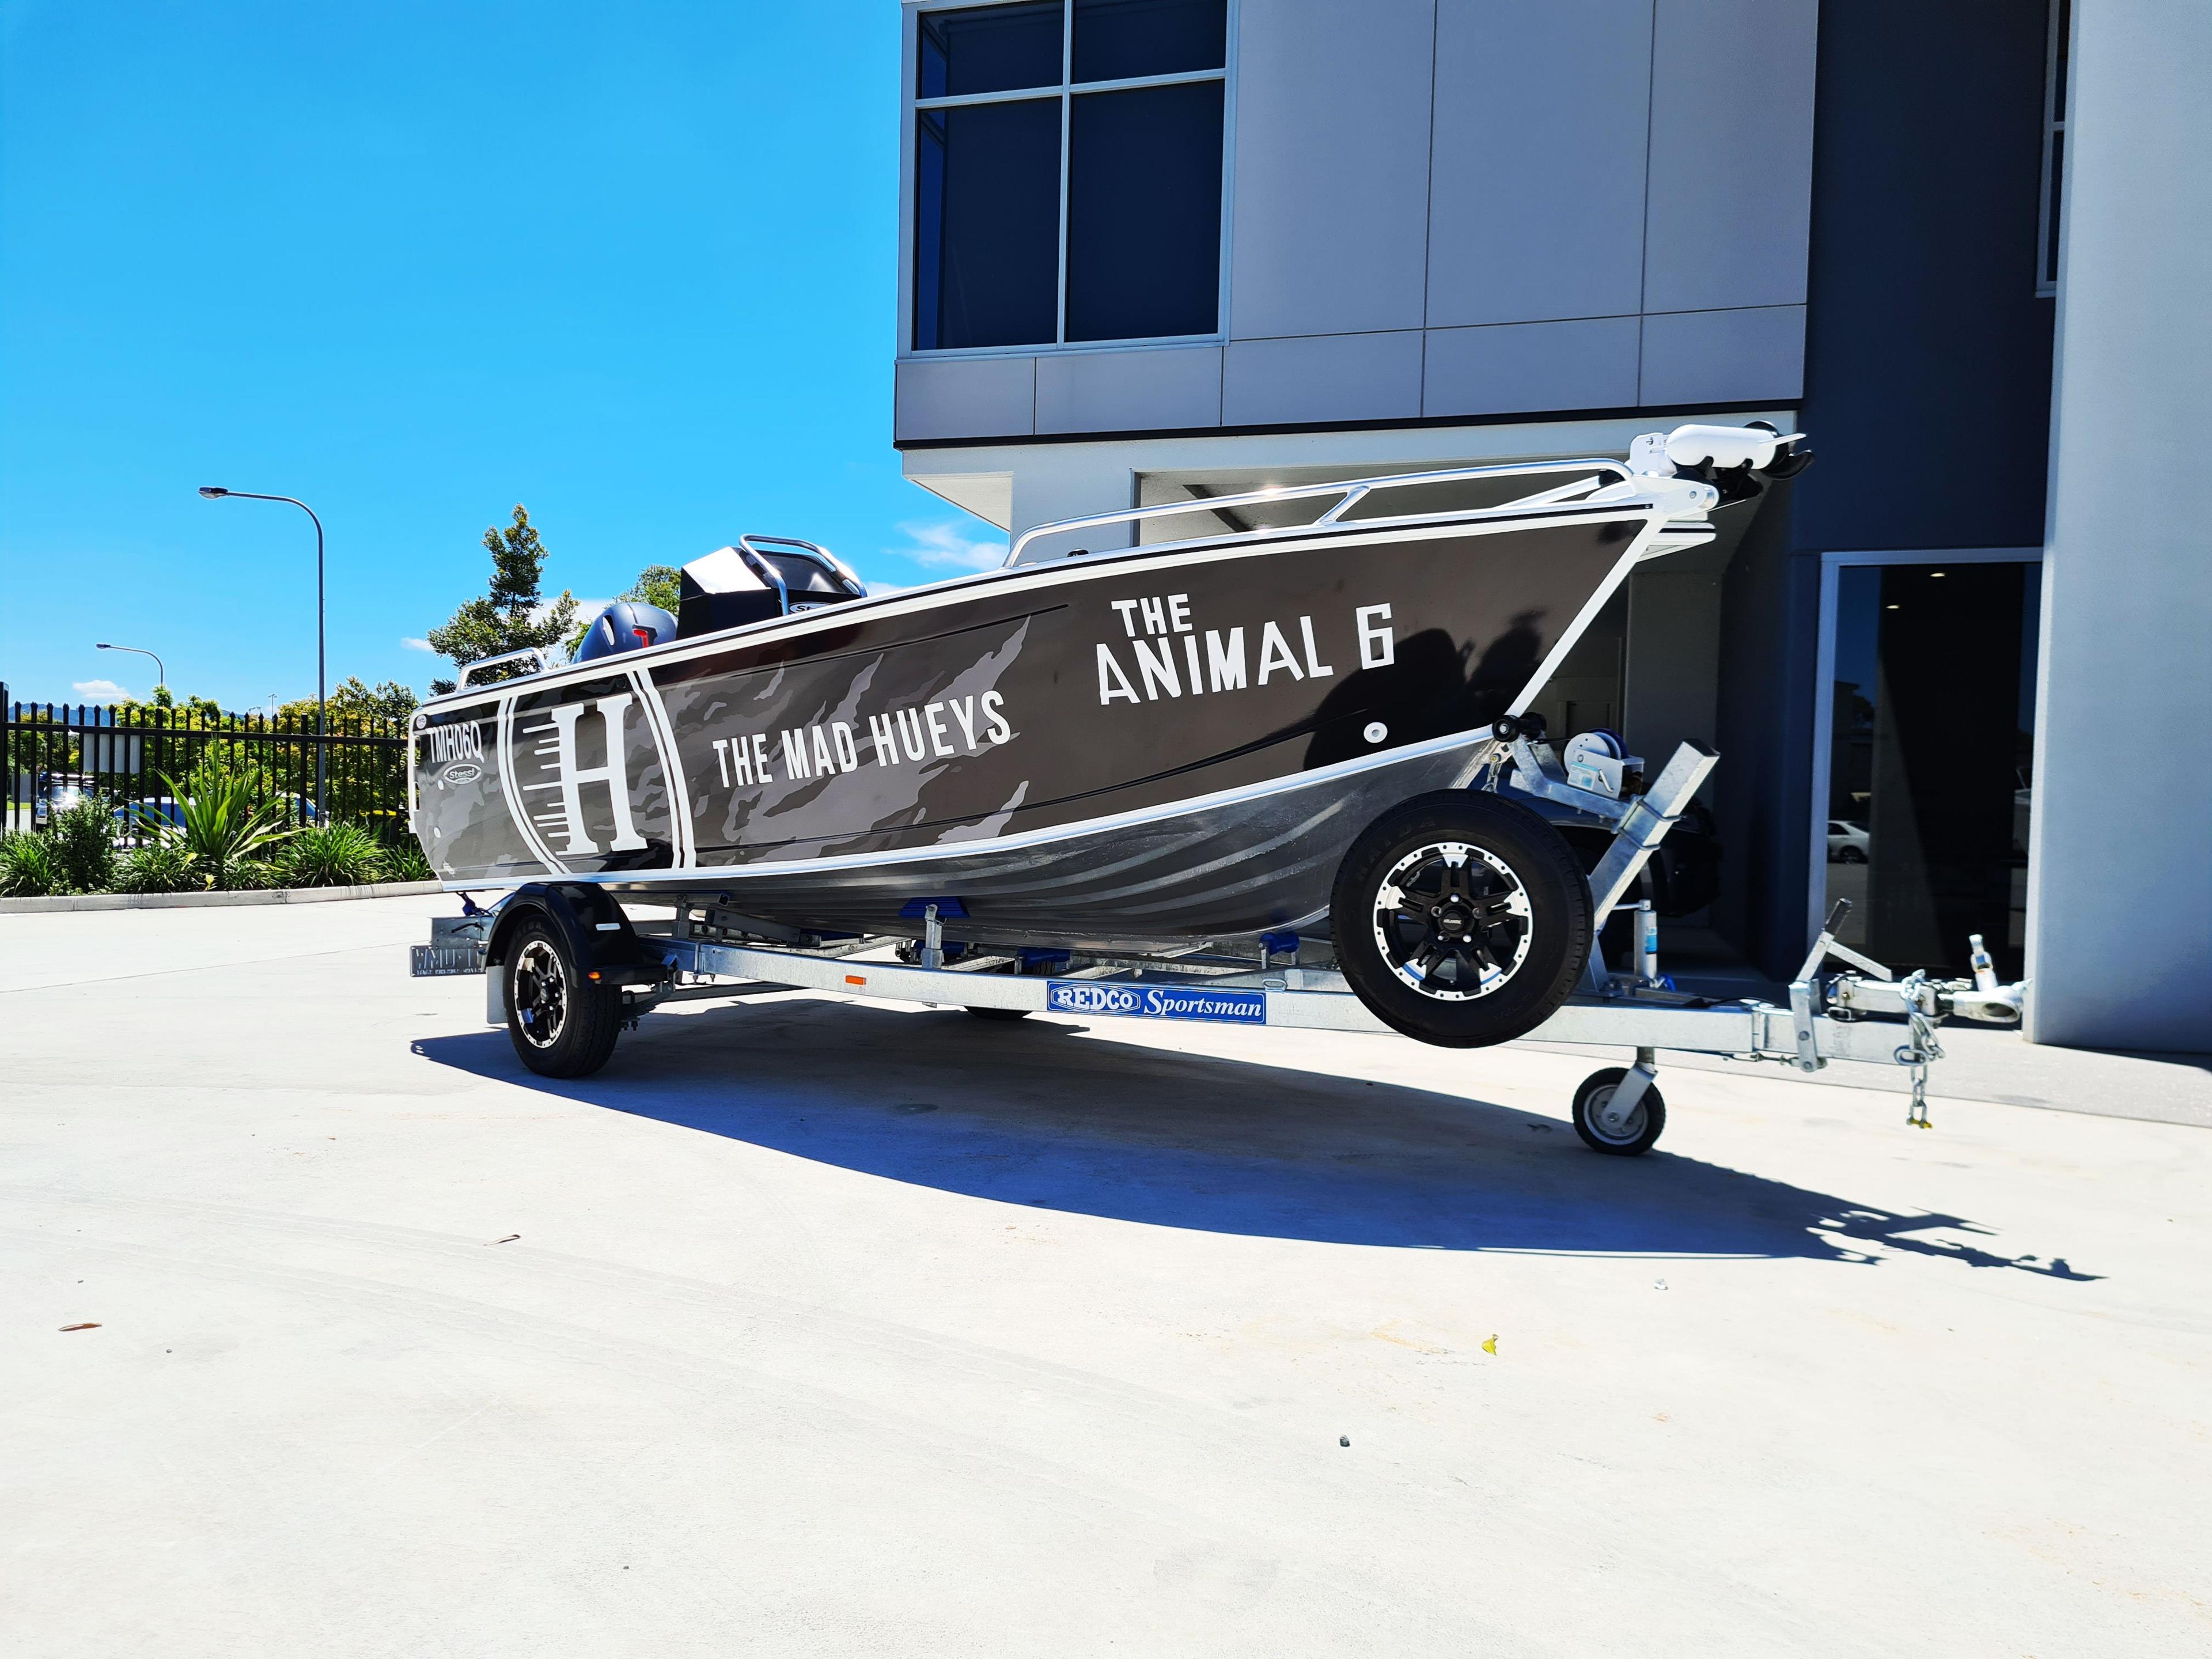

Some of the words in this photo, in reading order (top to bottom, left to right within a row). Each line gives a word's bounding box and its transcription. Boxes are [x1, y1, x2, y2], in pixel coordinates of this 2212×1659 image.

[1111, 593, 1192, 637] THE
[1096, 615, 1334, 706] ANIMAL
[1355, 603, 1395, 670] 6
[425, 720, 484, 763] TMH06Q
[551, 693, 648, 855] H
[712, 733, 773, 788] THE
[781, 721, 858, 781] MAD
[869, 690, 1012, 767] HUEYS
[1056, 987, 1133, 1011] REDCO
[1143, 990, 1262, 1016] Sportsman
